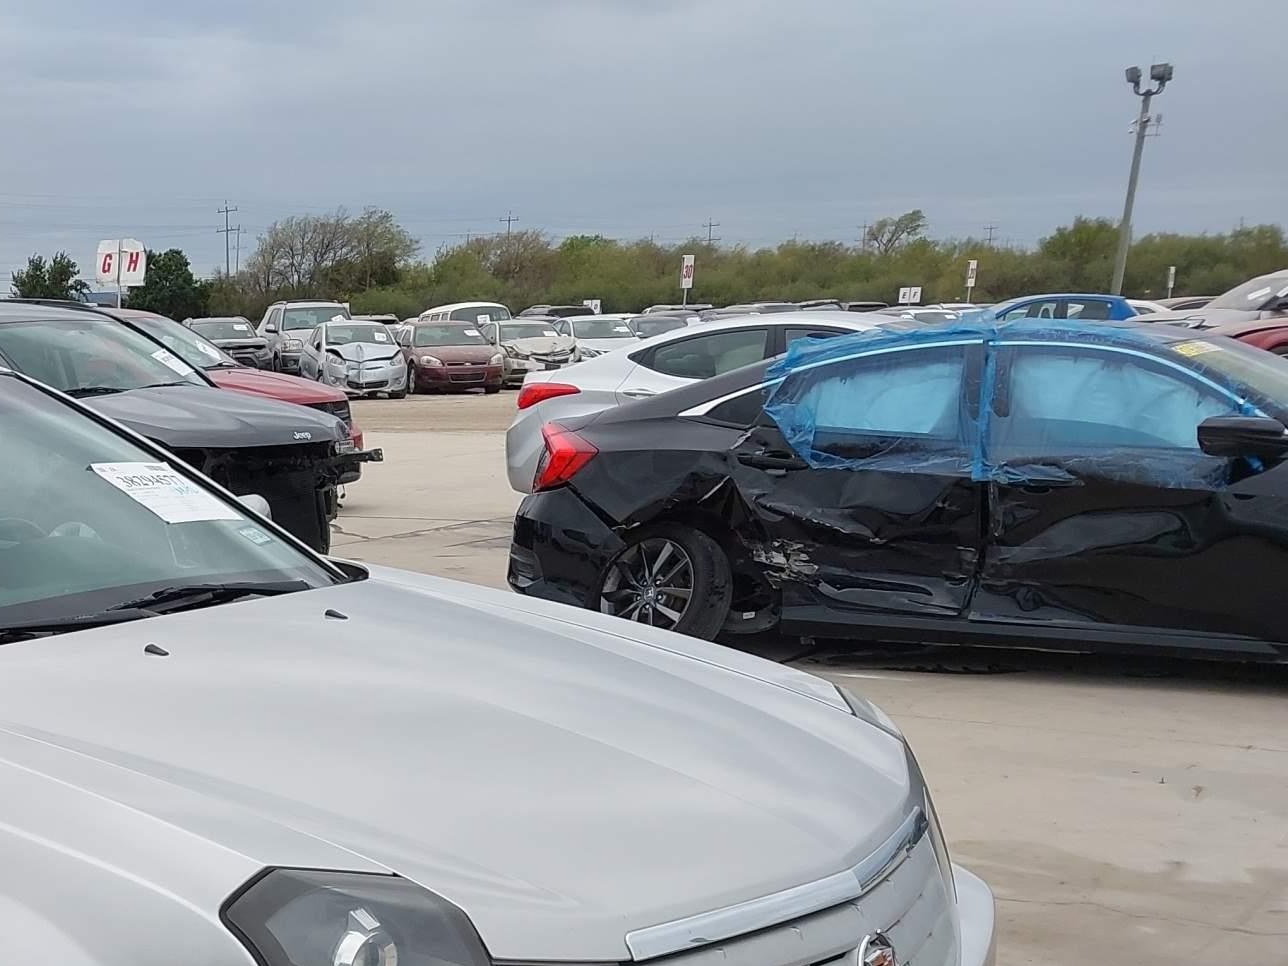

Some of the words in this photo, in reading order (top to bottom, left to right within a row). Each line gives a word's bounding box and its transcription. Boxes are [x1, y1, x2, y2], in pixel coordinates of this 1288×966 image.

[102, 253, 113, 274] G
[127, 251, 140, 273] H
[293, 431, 312, 440] Jeep
[115, 474, 186, 488] 38294577
